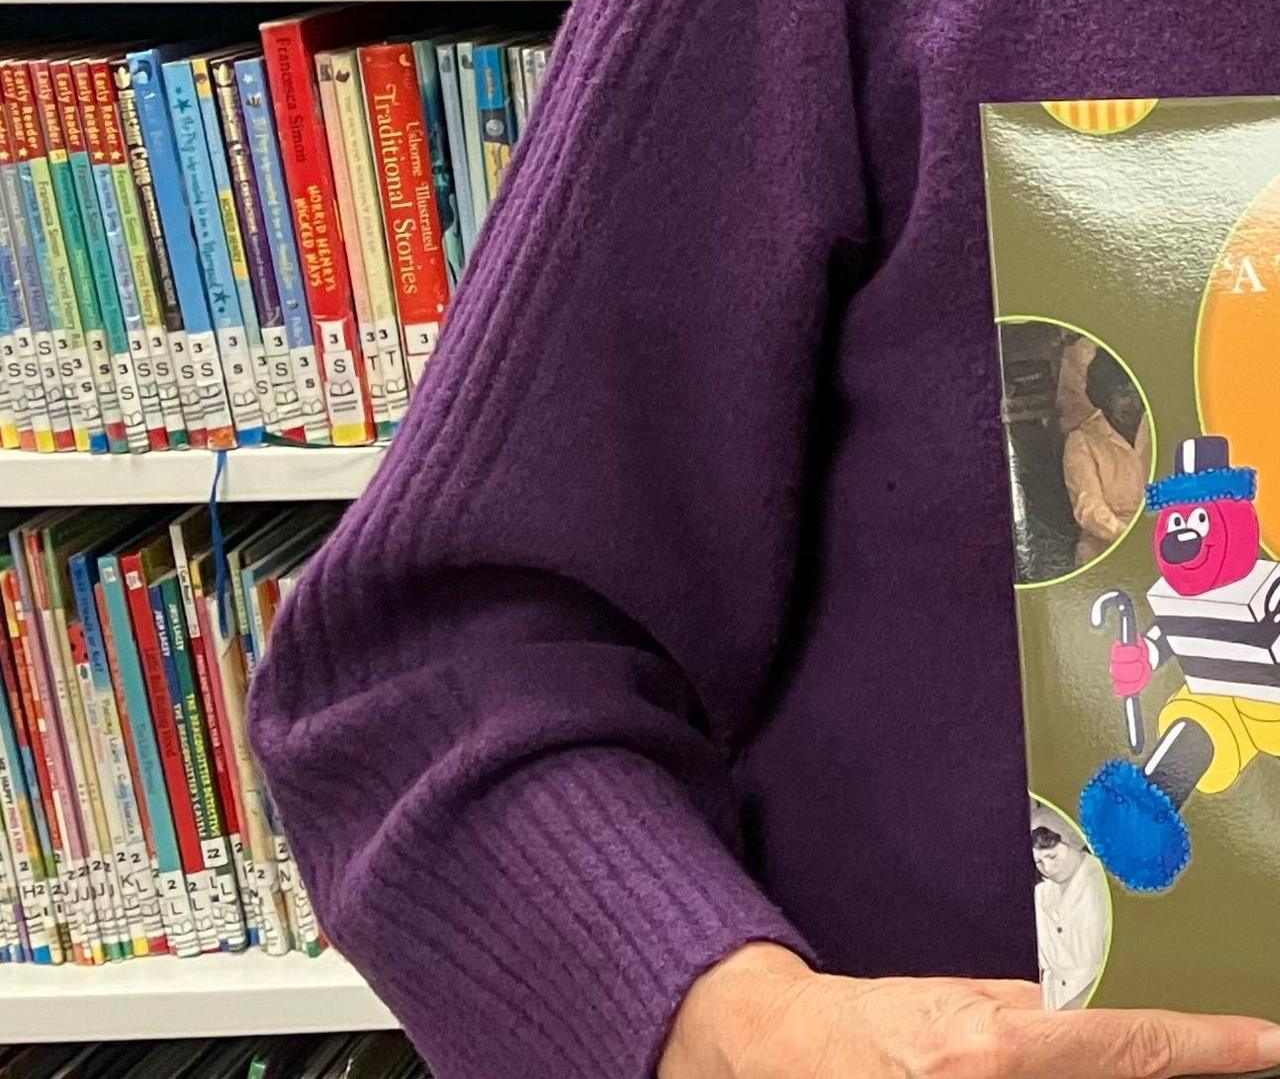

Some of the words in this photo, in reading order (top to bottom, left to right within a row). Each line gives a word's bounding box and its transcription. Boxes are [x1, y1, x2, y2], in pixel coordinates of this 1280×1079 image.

[94, 72, 112, 102] Early
[100, 106, 117, 145] Reader
[307, 185, 325, 234] HORRID
[374, 84, 412, 209] Traditional
[393, 219, 419, 294] Stories
[405, 122, 424, 177] Usborne
[415, 183, 438, 252] Illustrated
[294, 198, 313, 250] WICKED
[303, 252, 321, 287] WAYS
